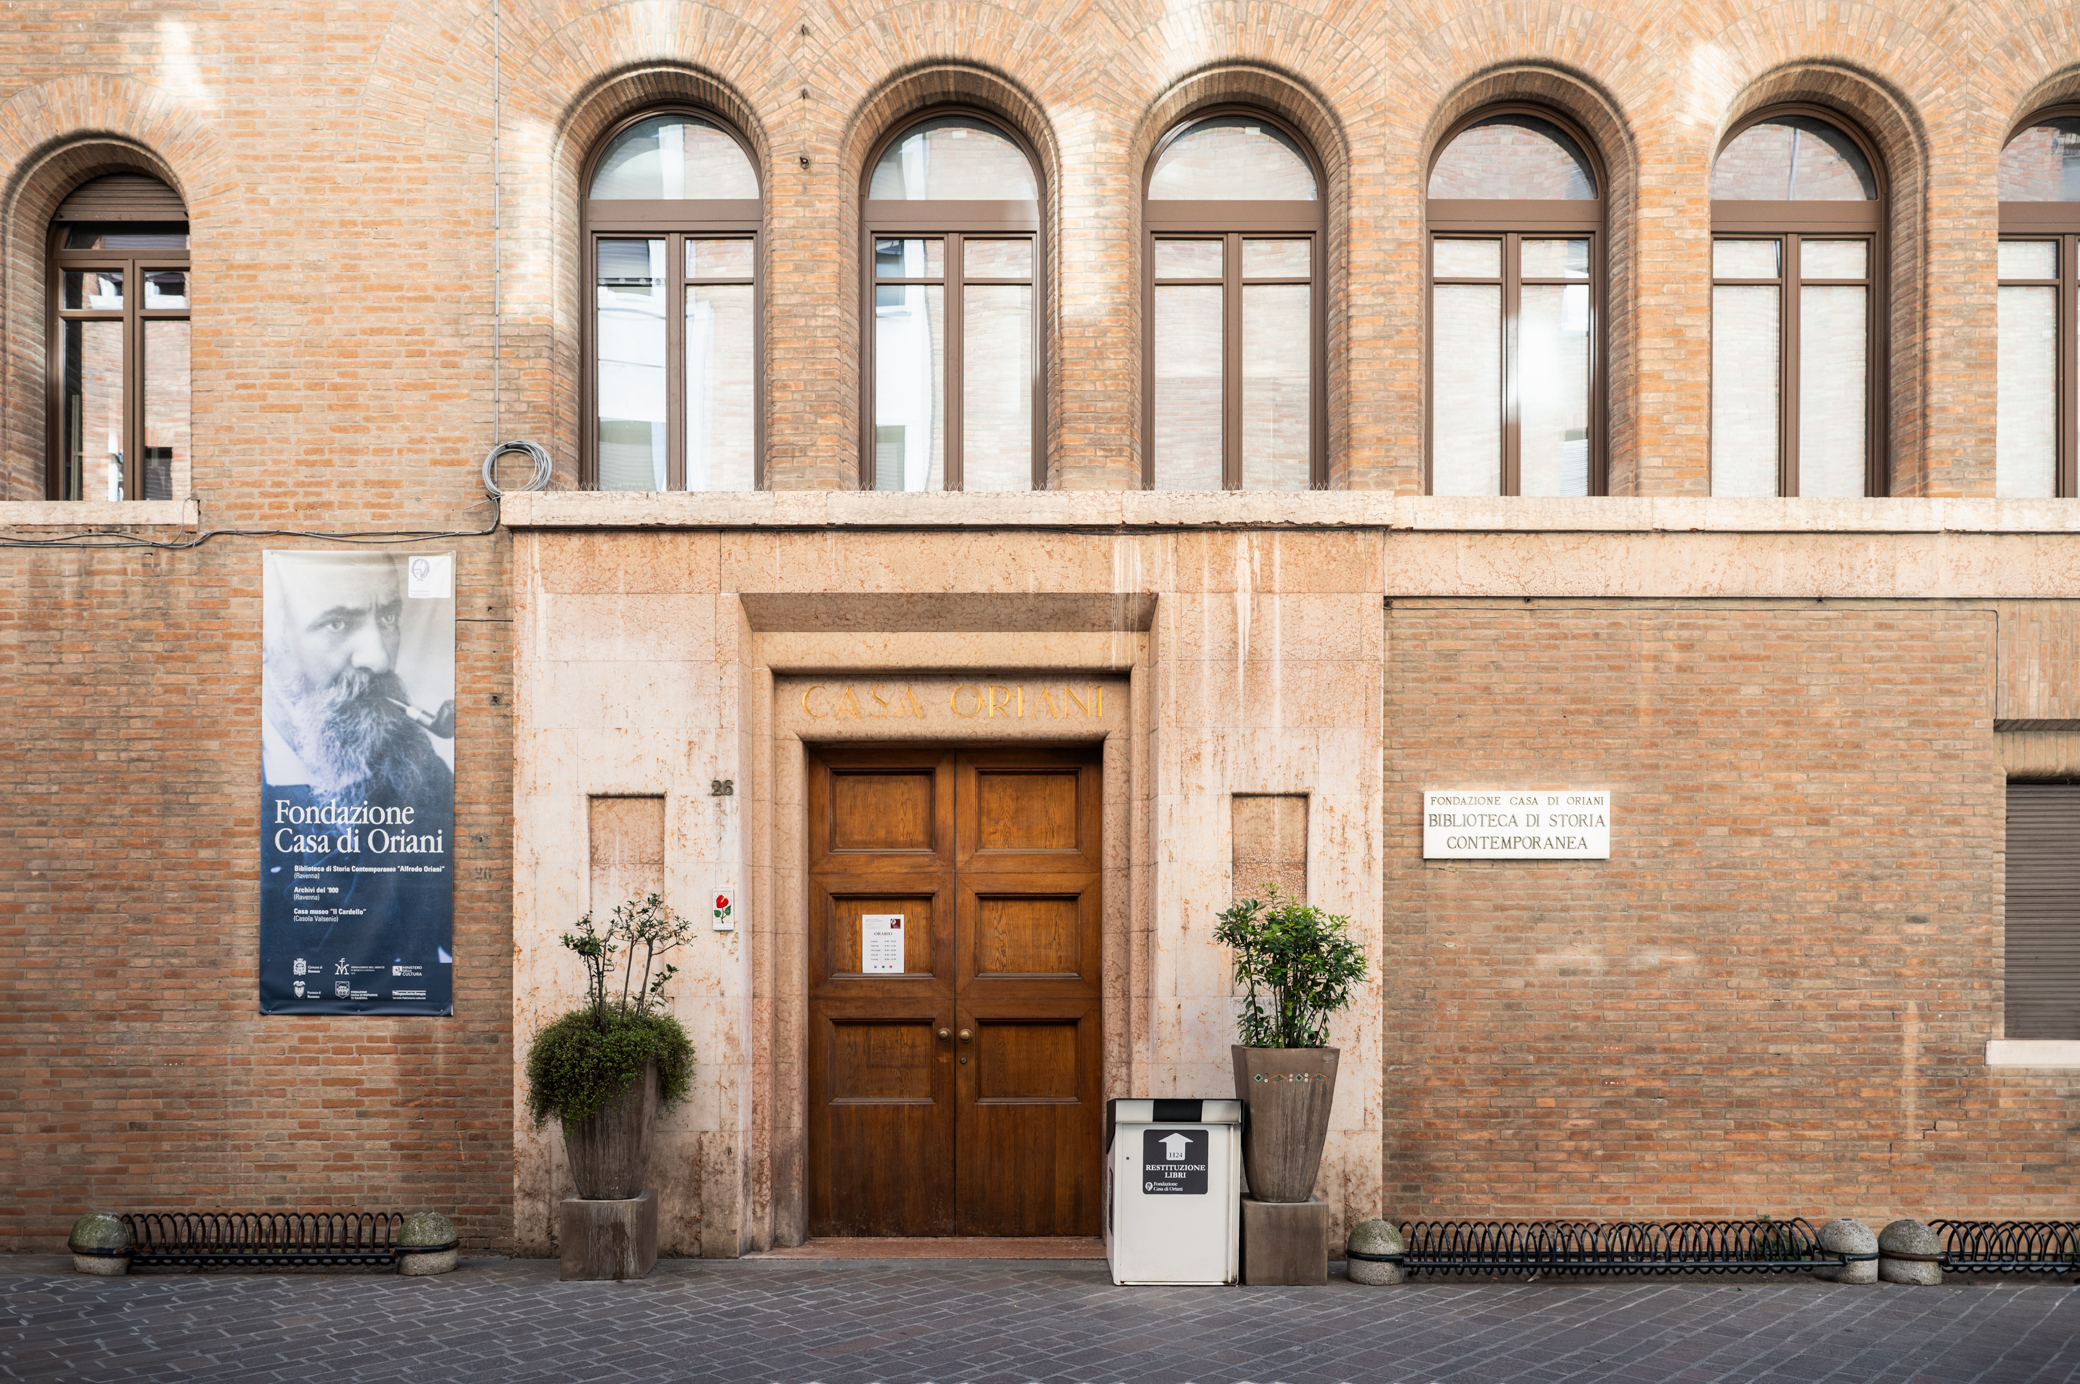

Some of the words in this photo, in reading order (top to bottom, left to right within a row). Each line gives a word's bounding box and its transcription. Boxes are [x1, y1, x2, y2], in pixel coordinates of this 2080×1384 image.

[802, 685, 922, 719] CASA
[950, 684, 1102, 718] ORIANI
[711, 779, 734, 796] 26
[1430, 796, 1501, 805] FONDAZIONE
[1509, 796, 1539, 805] CASA
[1547, 796, 1559, 805] DI
[1566, 796, 1604, 805] ORIANI
[274, 799, 415, 825] Fondazione
[1428, 814, 1519, 827] BIBLIOTECA
[1526, 814, 1540, 827] DI
[1548, 814, 1606, 827] STORIA
[274, 827, 331, 853] Casa
[336, 827, 361, 853] di
[367, 828, 444, 854] Oriani
[1446, 835, 1588, 849] CONTEMPORANEA
[293, 872, 320, 880] (Ravenna)
[351, 865, 396, 874] Contemporanea
